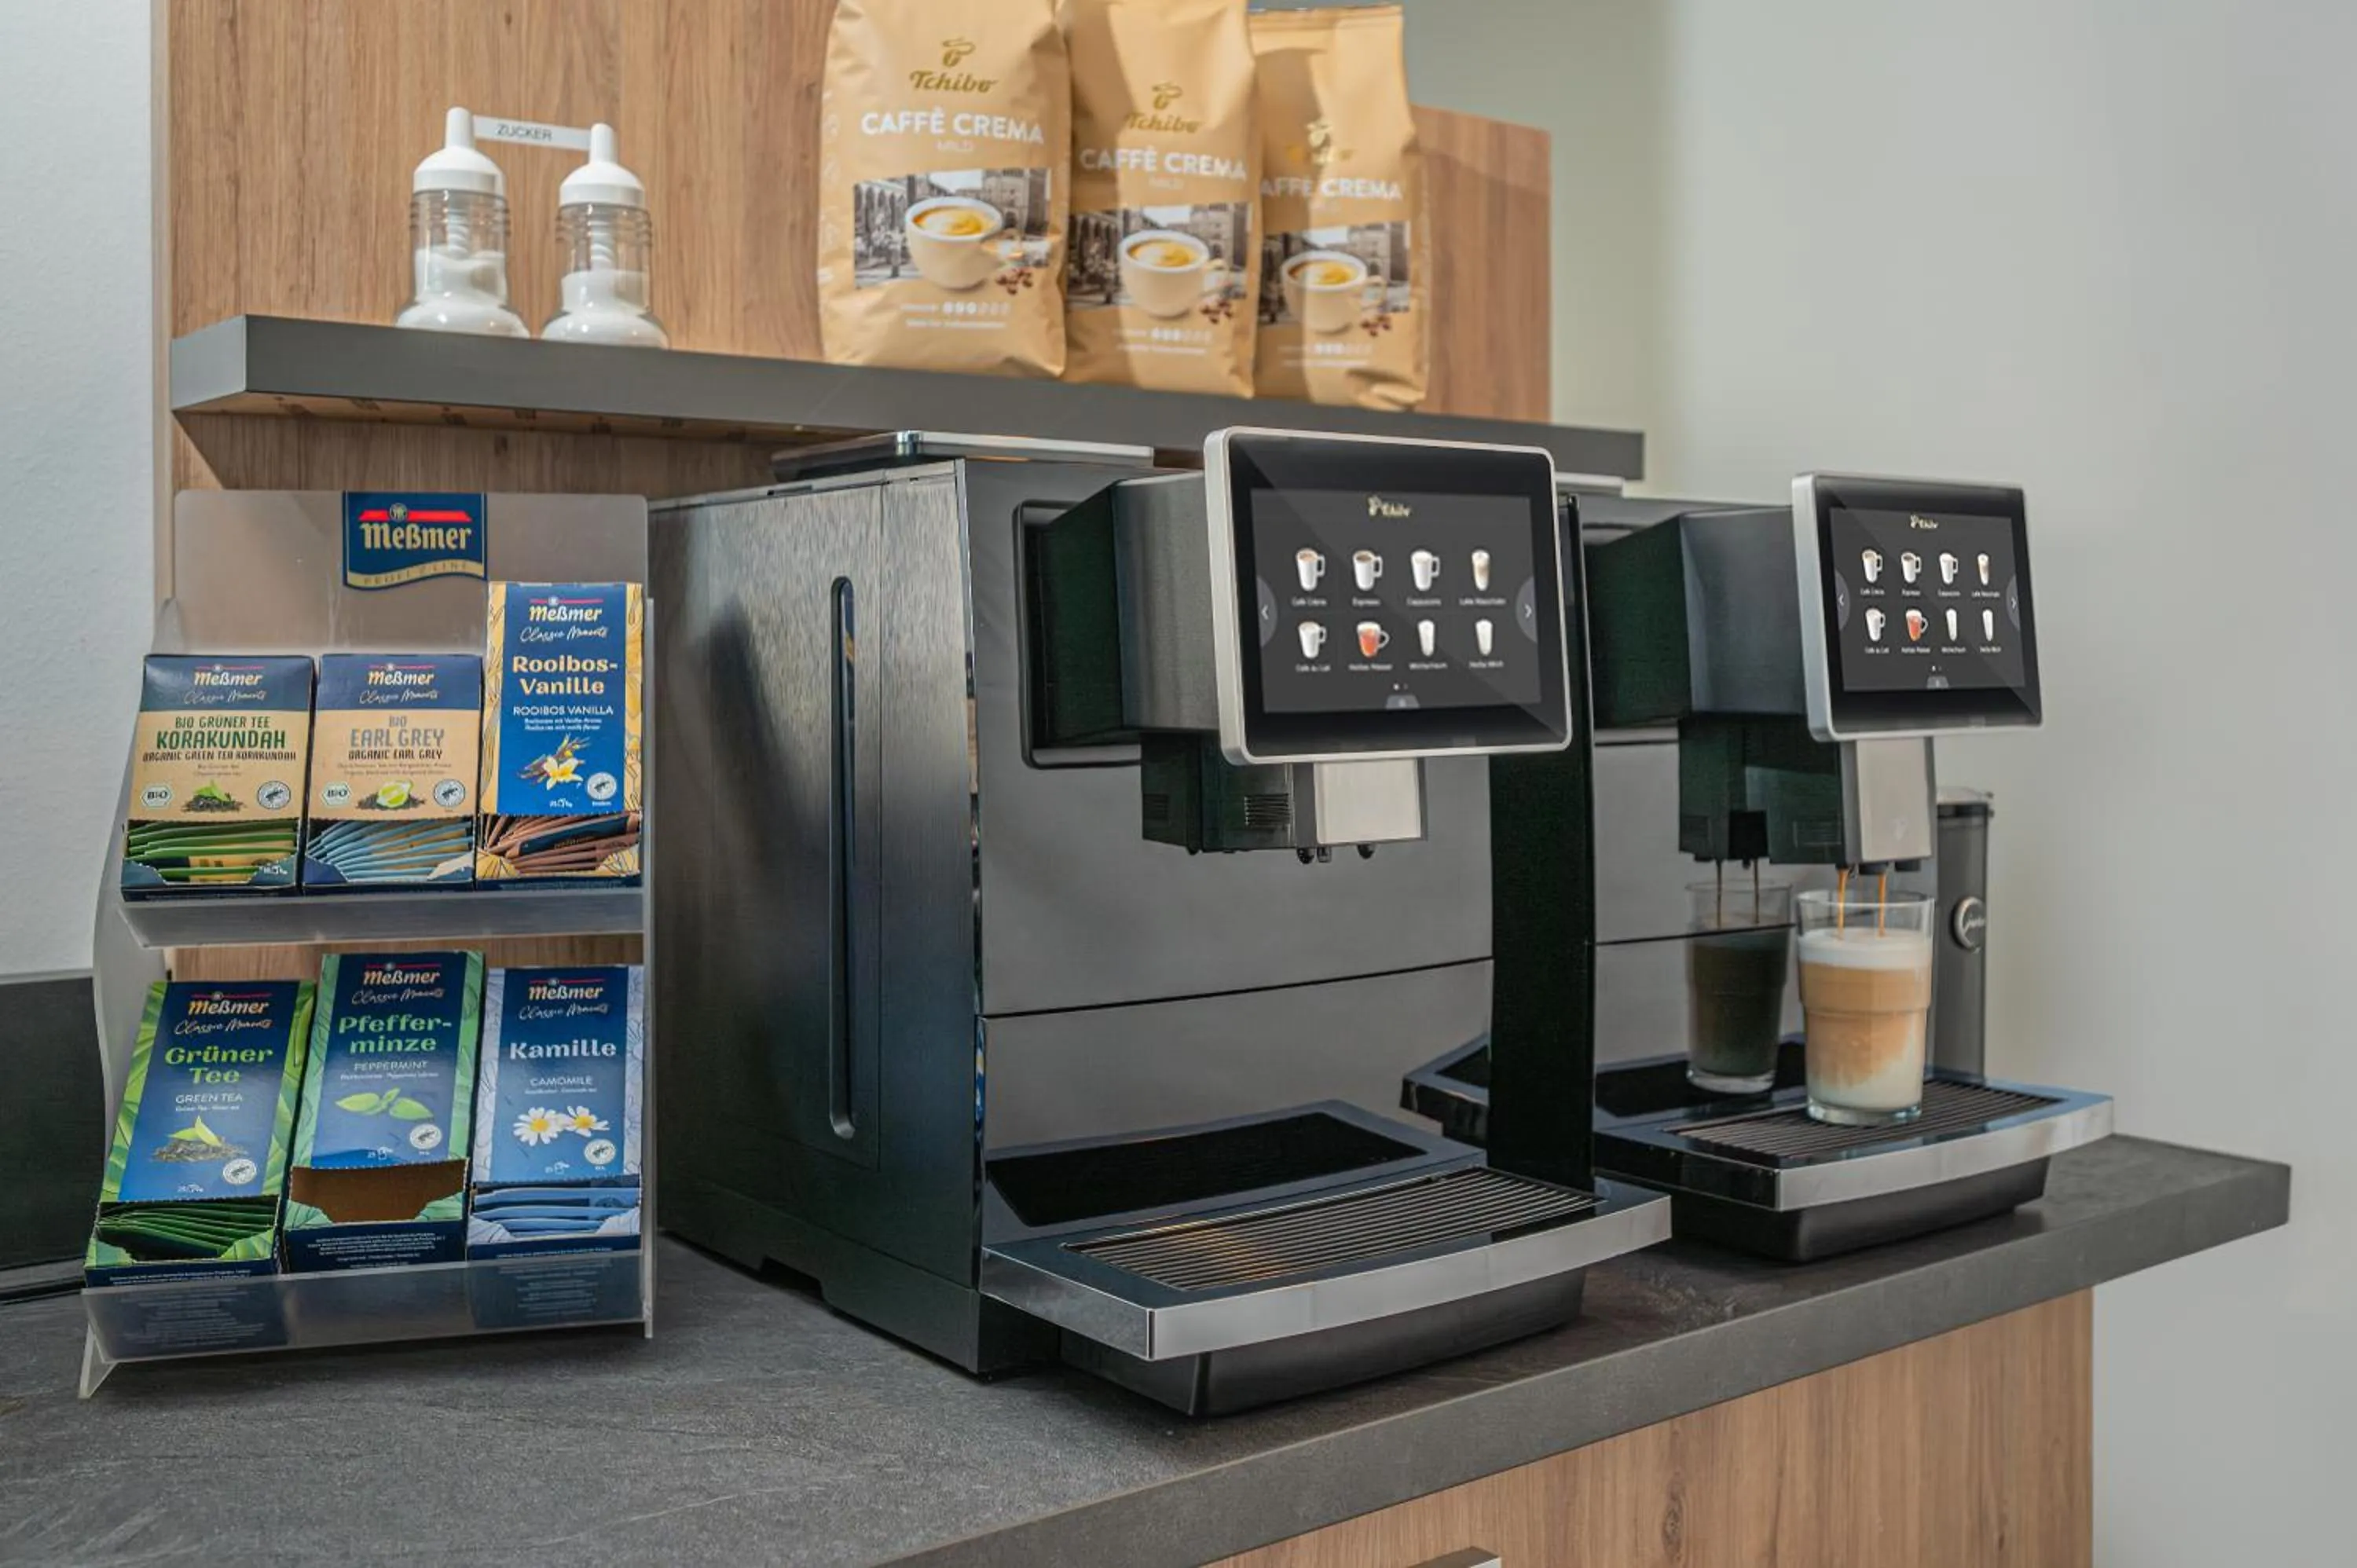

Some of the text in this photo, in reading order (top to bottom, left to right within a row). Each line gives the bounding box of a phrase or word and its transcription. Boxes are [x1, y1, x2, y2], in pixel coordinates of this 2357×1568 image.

[908, 70, 999, 93] Tchibo
[860, 105, 1044, 145] CAFFÈ CREMA
[1125, 112, 1202, 134] Tchibo
[497, 123, 553, 141] ZUCKER
[1079, 145, 1248, 181] CAFFÈ CREMA
[1320, 178, 1403, 202] CREMA
[359, 522, 471, 549] Meßmer
[529, 605, 603, 622] Meßmer
[512, 654, 618, 673] Rooibos-
[194, 671, 263, 686] Meßmer
[367, 671, 434, 686] Meßmer
[519, 676, 605, 695] Vanille
[512, 705, 614, 716] ROOIBOS VANILLA
[175, 714, 271, 729] BIO GRÜNER TEE
[388, 715, 408, 727] BIO
[156, 730, 286, 749] KORAKUNDAH
[350, 728, 445, 748] EARL GREY
[142, 750, 297, 763] ORGANIC GREEN TEA KORAKUNDAH
[348, 749, 443, 760] ORGANIC EARL GREY
[146, 790, 168, 800] BIO
[364, 969, 441, 986] Meßmer
[528, 985, 603, 1001] Meßmer
[189, 999, 269, 1016] Meßmer
[339, 1013, 453, 1034] Pfeffer-
[349, 1035, 438, 1054] minze
[510, 1039, 617, 1060] Kamille
[164, 1045, 273, 1064] Grüner
[354, 1061, 428, 1072] PEPPERMINT
[189, 1067, 241, 1084] Tee
[530, 1075, 593, 1087] CAMOMILE
[175, 1091, 243, 1105] GREEN TEA
